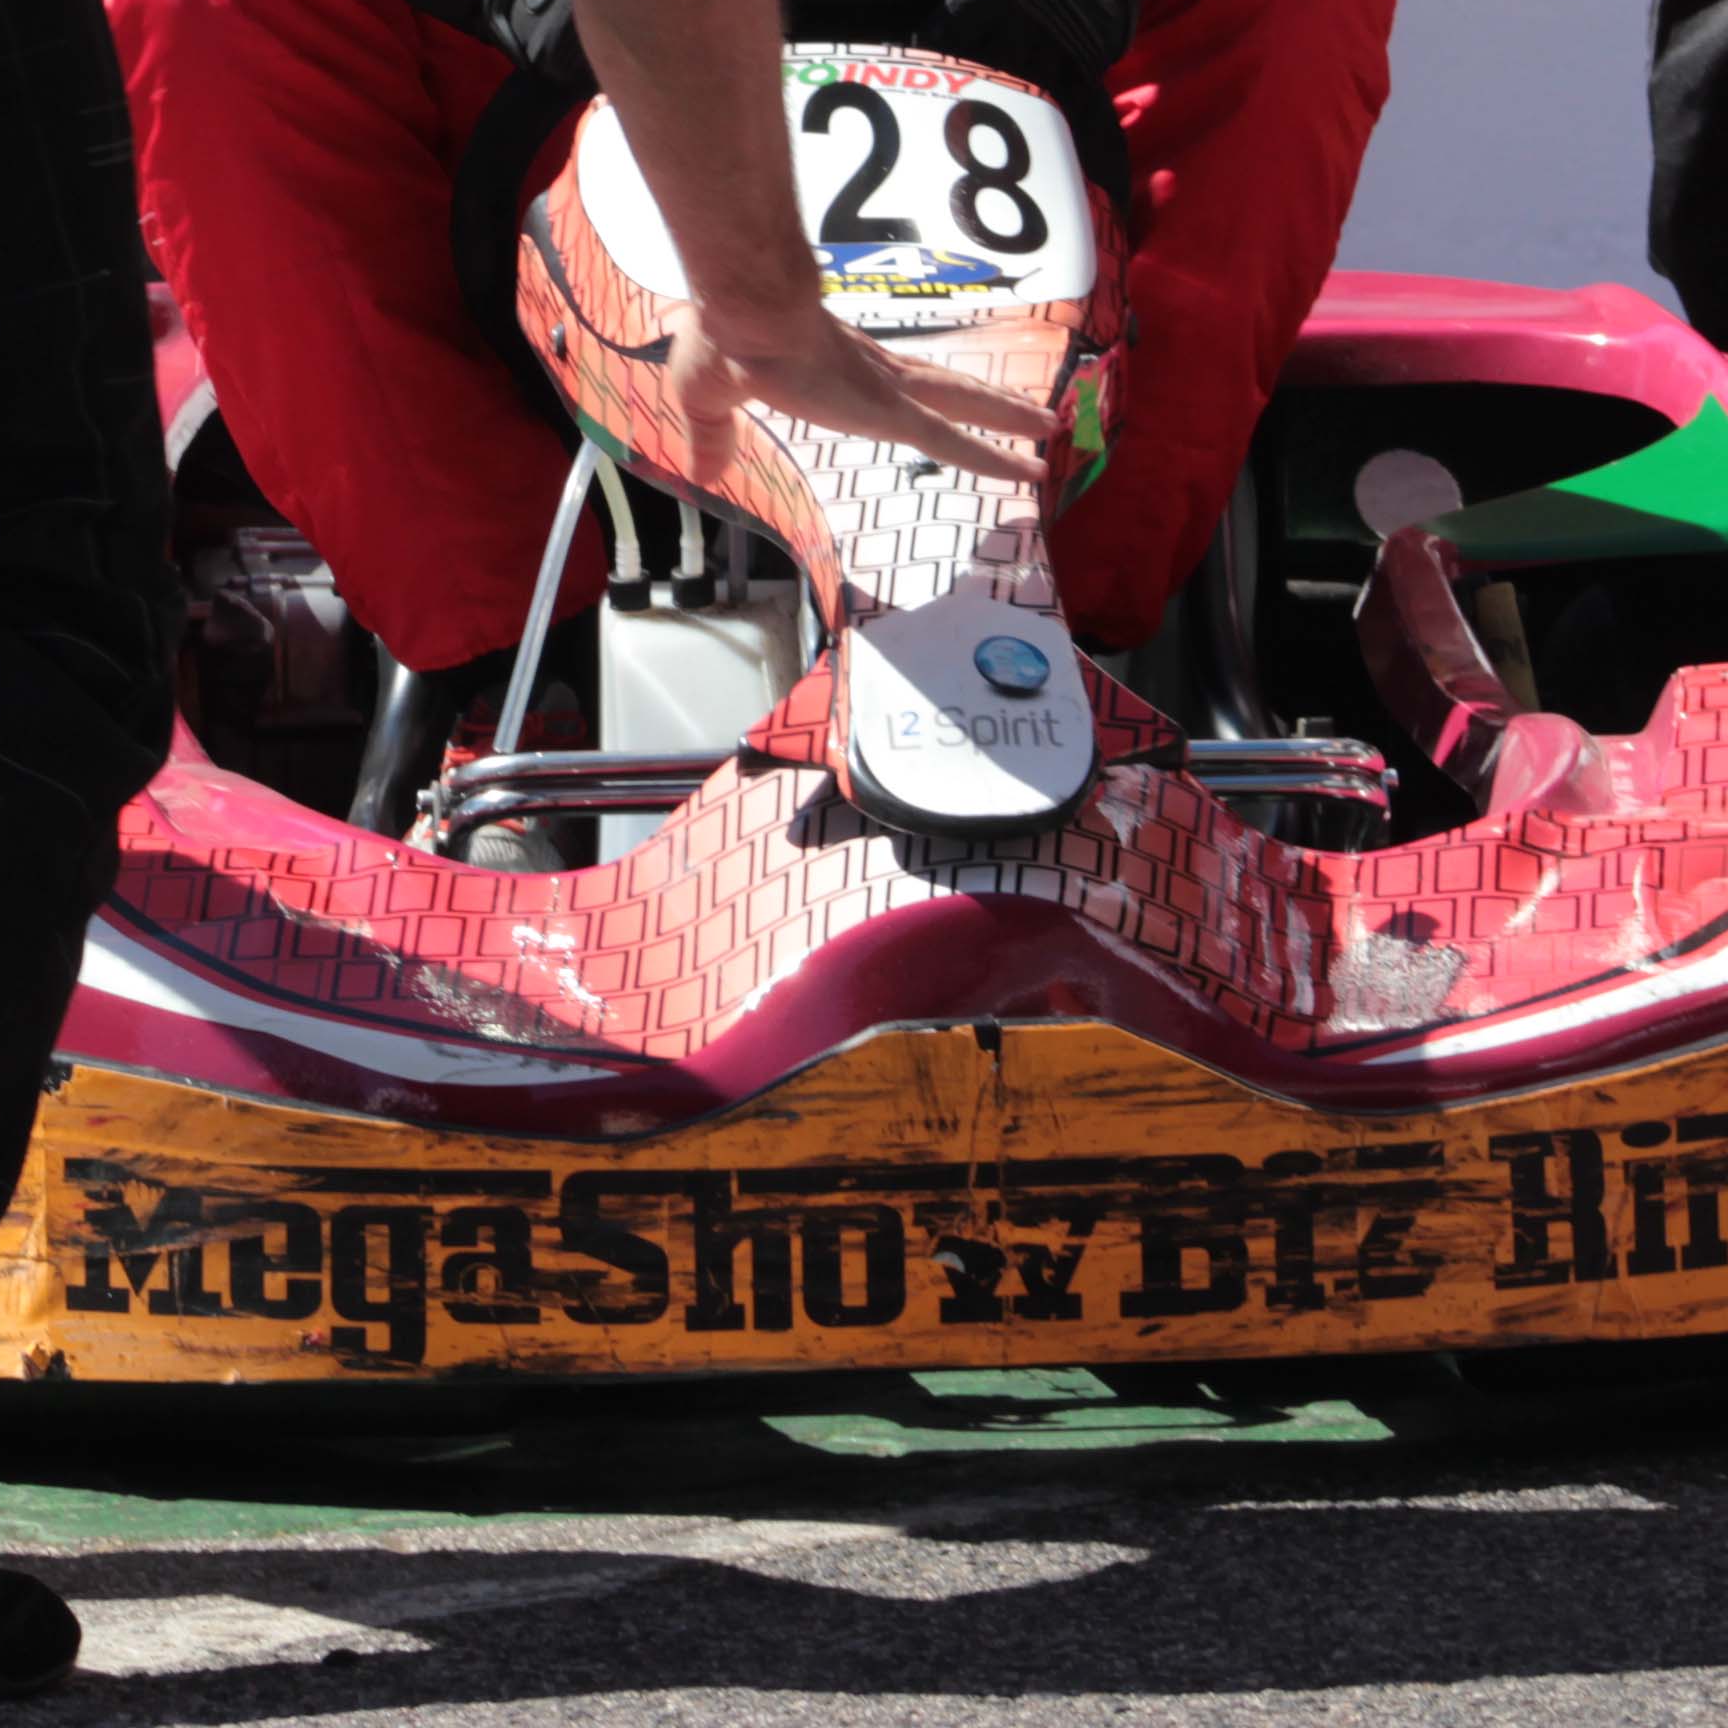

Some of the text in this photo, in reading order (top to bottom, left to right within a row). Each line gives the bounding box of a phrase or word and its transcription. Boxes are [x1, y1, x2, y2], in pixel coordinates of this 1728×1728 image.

[782, 62, 976, 95] OINDY
[801, 81, 1049, 255] 28
[934, 705, 1064, 756] Spirit
